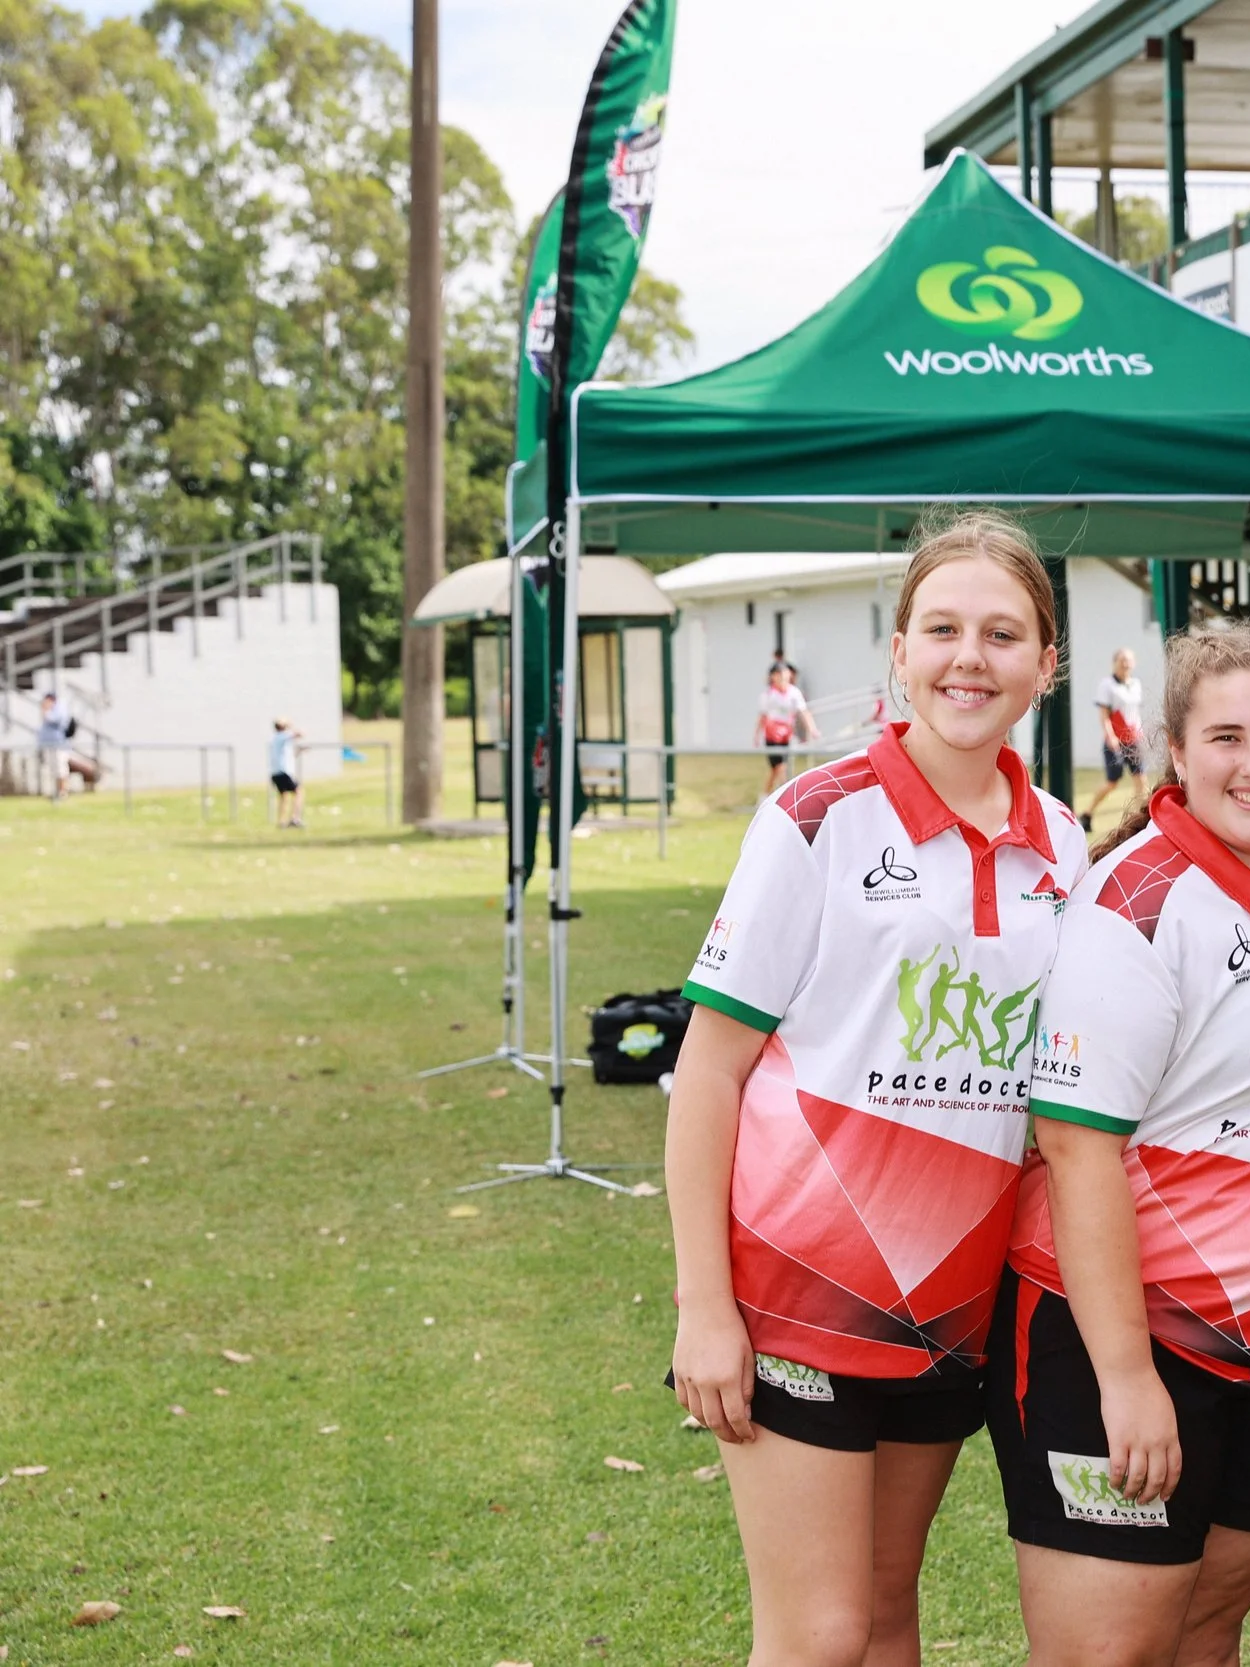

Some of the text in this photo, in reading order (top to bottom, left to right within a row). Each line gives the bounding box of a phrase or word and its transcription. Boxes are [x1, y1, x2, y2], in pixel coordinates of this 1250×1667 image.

[864, 887, 921, 895] MURWILLUMBAH
[868, 1070, 947, 1093] pace
[1053, 1078, 1078, 1088] GROUP
[867, 1095, 889, 1106] THE
[892, 1097, 911, 1107] ART
[913, 1098, 935, 1108] AND
[938, 1099, 976, 1111] SCIENCE
[977, 1102, 990, 1111] OF
[993, 1104, 1011, 1112] FAST
[1068, 1504, 1103, 1517] pace
